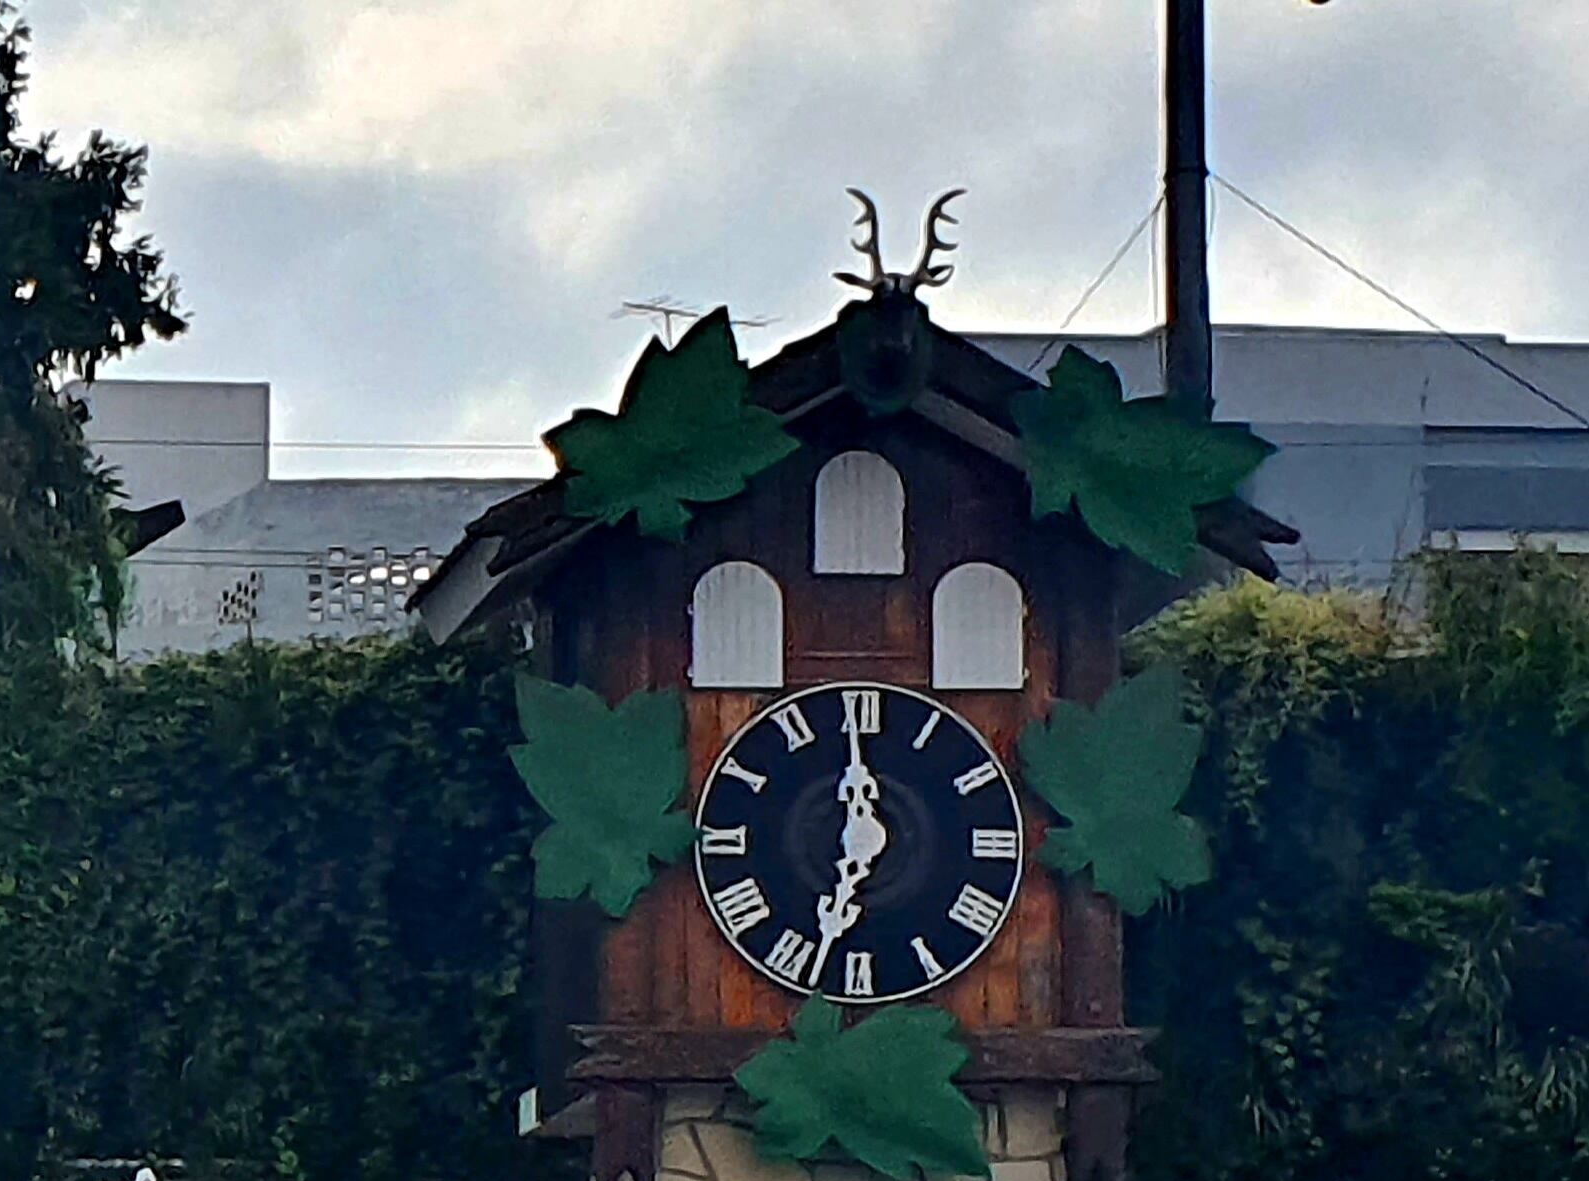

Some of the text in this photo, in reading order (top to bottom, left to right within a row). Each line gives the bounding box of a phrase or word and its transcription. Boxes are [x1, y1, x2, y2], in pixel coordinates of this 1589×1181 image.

[841, 690, 880, 733] XII
[912, 711, 940, 749] I
[953, 760, 999, 795] II
[972, 828, 1017, 858] III
[713, 878, 770, 937] VIII
[948, 883, 1004, 936] IIII
[764, 929, 814, 982] VII
[844, 952, 874, 995] VI
